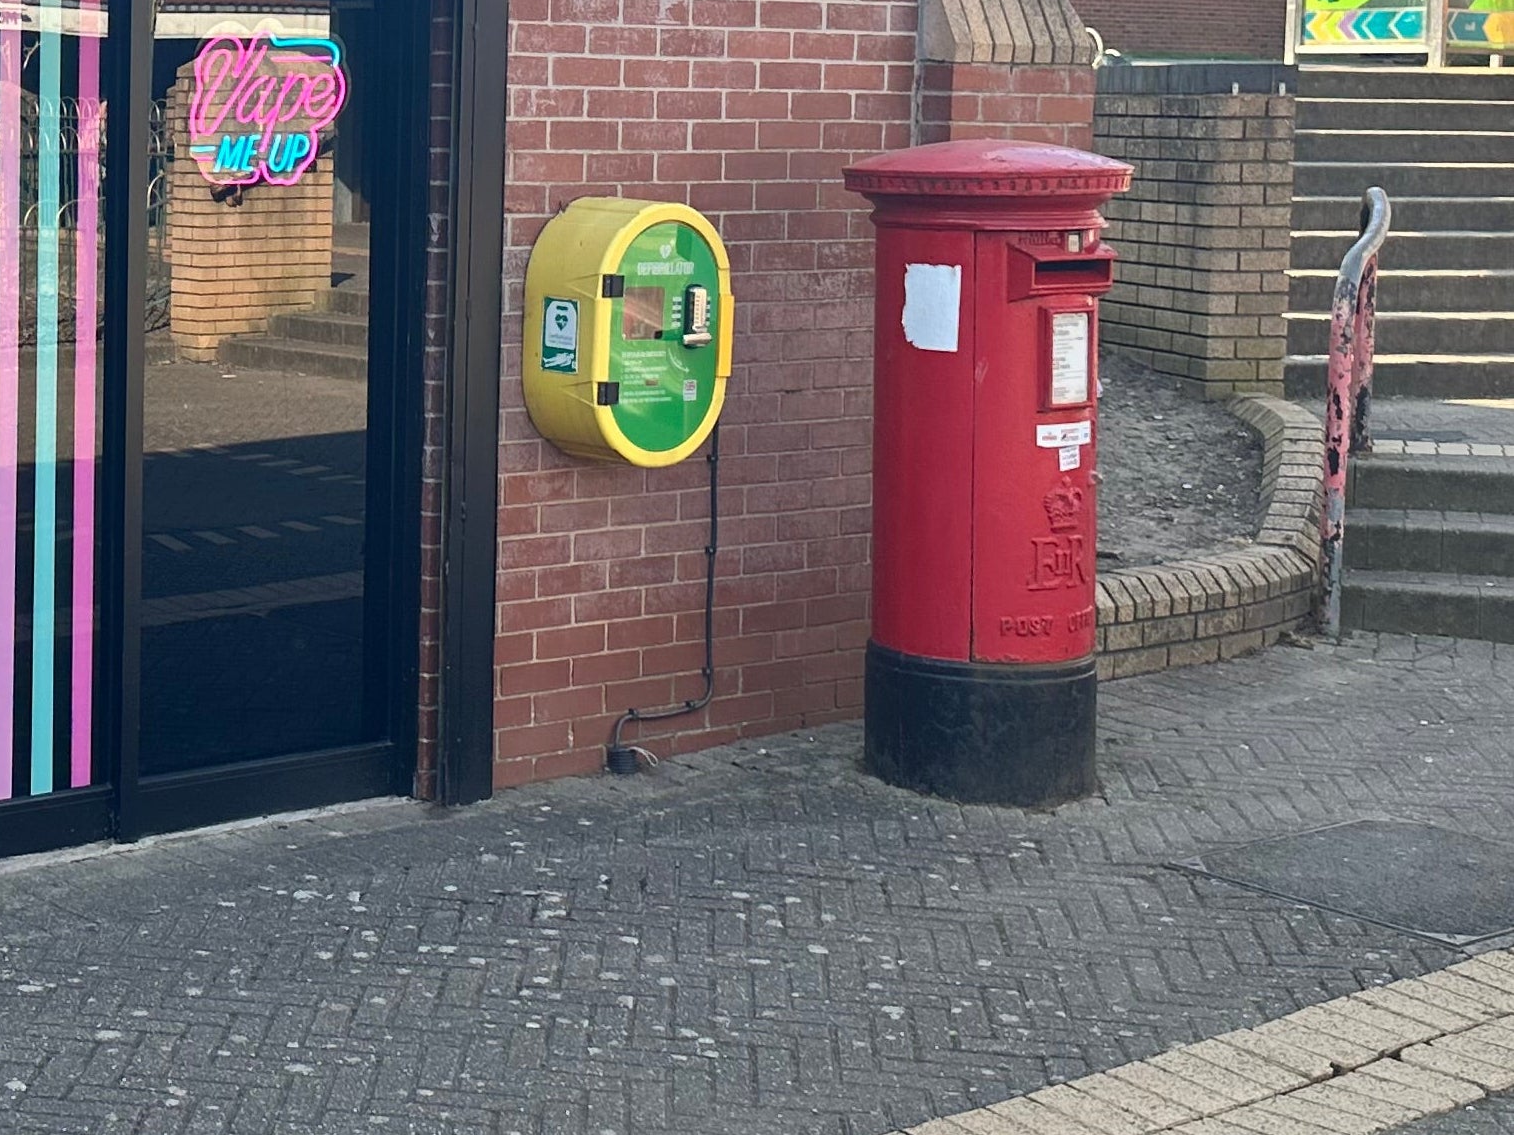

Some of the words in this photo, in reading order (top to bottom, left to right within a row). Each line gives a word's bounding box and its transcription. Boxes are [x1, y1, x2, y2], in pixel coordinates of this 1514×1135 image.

[198, 45, 337, 152] Vape
[213, 134, 261, 172] ME
[268, 133, 310, 172] UP
[1000, 616, 1054, 637] POST
